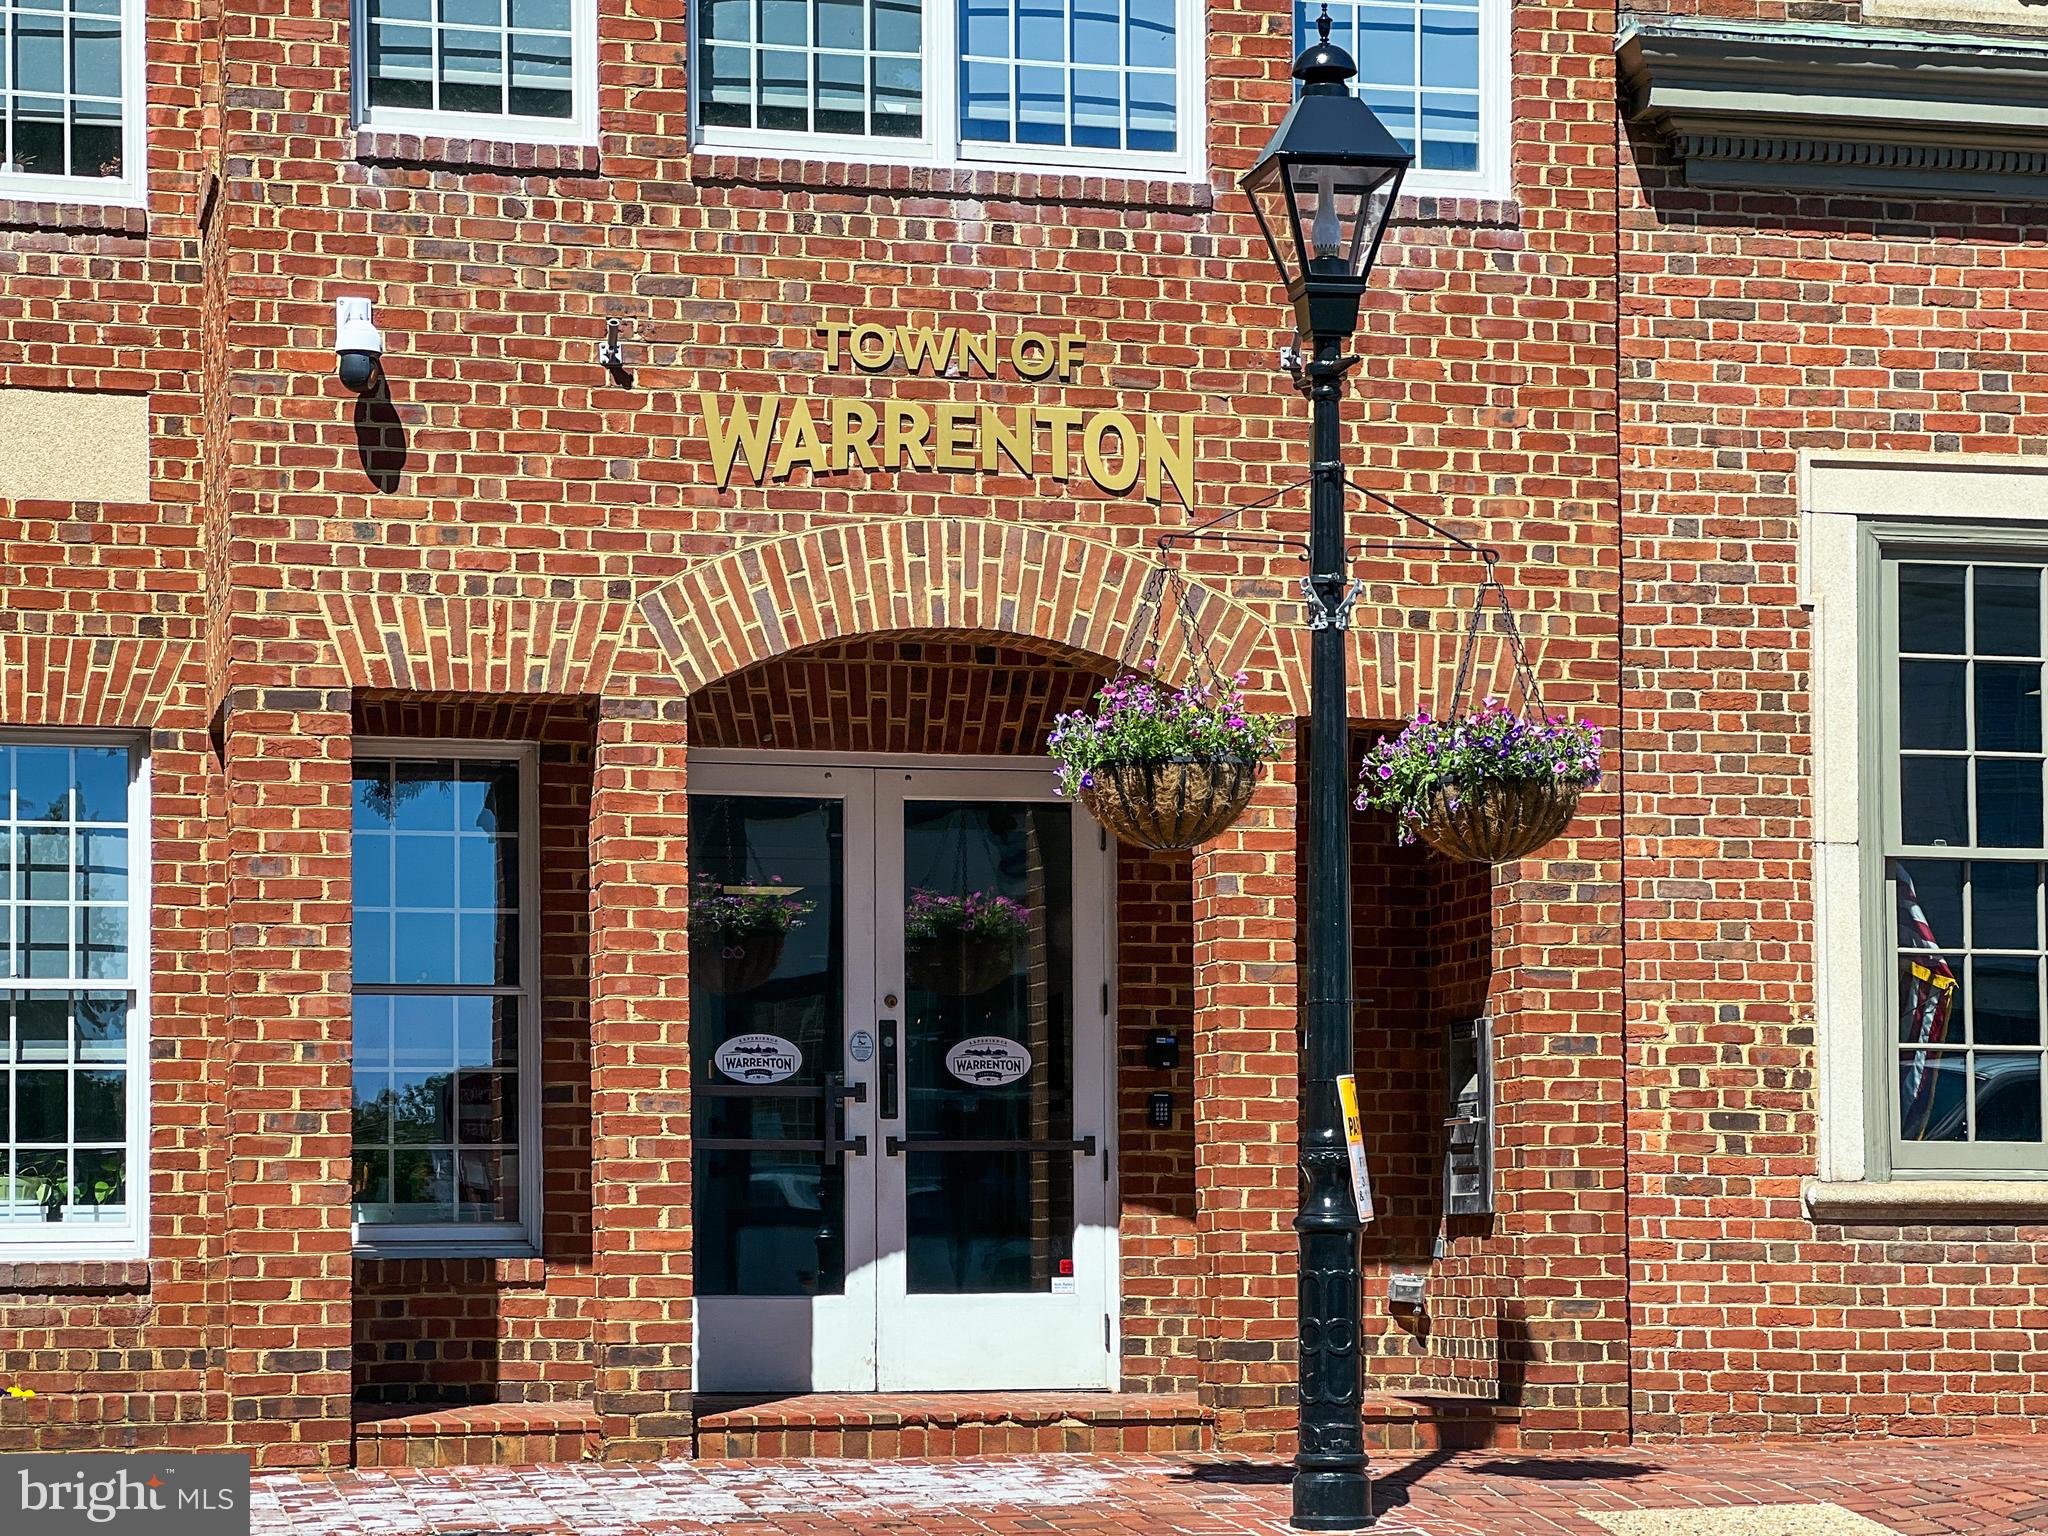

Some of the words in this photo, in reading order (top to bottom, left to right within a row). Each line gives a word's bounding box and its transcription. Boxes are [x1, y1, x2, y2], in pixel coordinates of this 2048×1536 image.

[816, 322, 996, 377] TOWN
[1011, 332, 1086, 379] OF
[701, 393, 1194, 512] WARRENTON
[725, 1057, 792, 1071] WARRENTON
[956, 1060, 1021, 1073] WARRENTON
